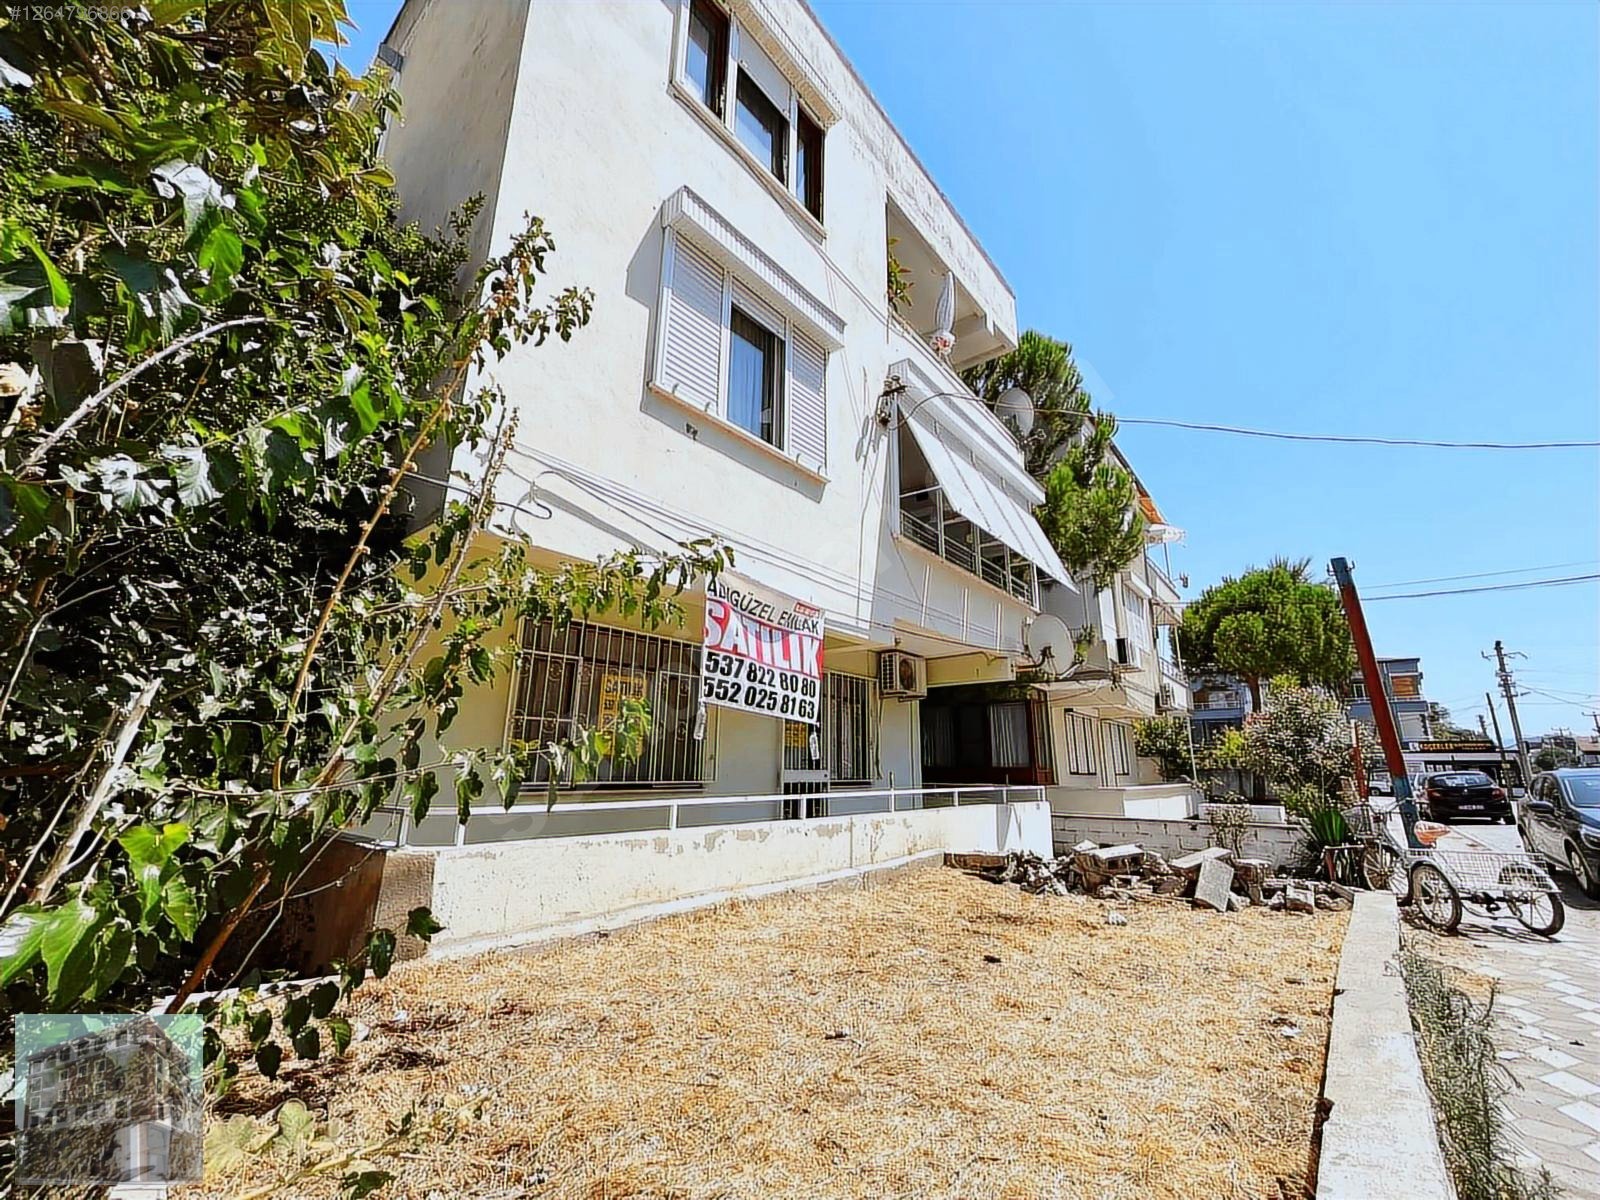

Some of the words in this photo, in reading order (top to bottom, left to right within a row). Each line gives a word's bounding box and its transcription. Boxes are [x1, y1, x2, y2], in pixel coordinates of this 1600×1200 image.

[704, 600, 820, 678] SATILIK
[703, 676, 742, 703] 552
[744, 686, 778, 711] 025
[780, 694, 796, 716] 81
[799, 700, 815, 719] 63
[705, 652, 744, 679] 537
[746, 662, 776, 688] 822
[780, 672, 799, 693] 80
[801, 680, 816, 698] 80
